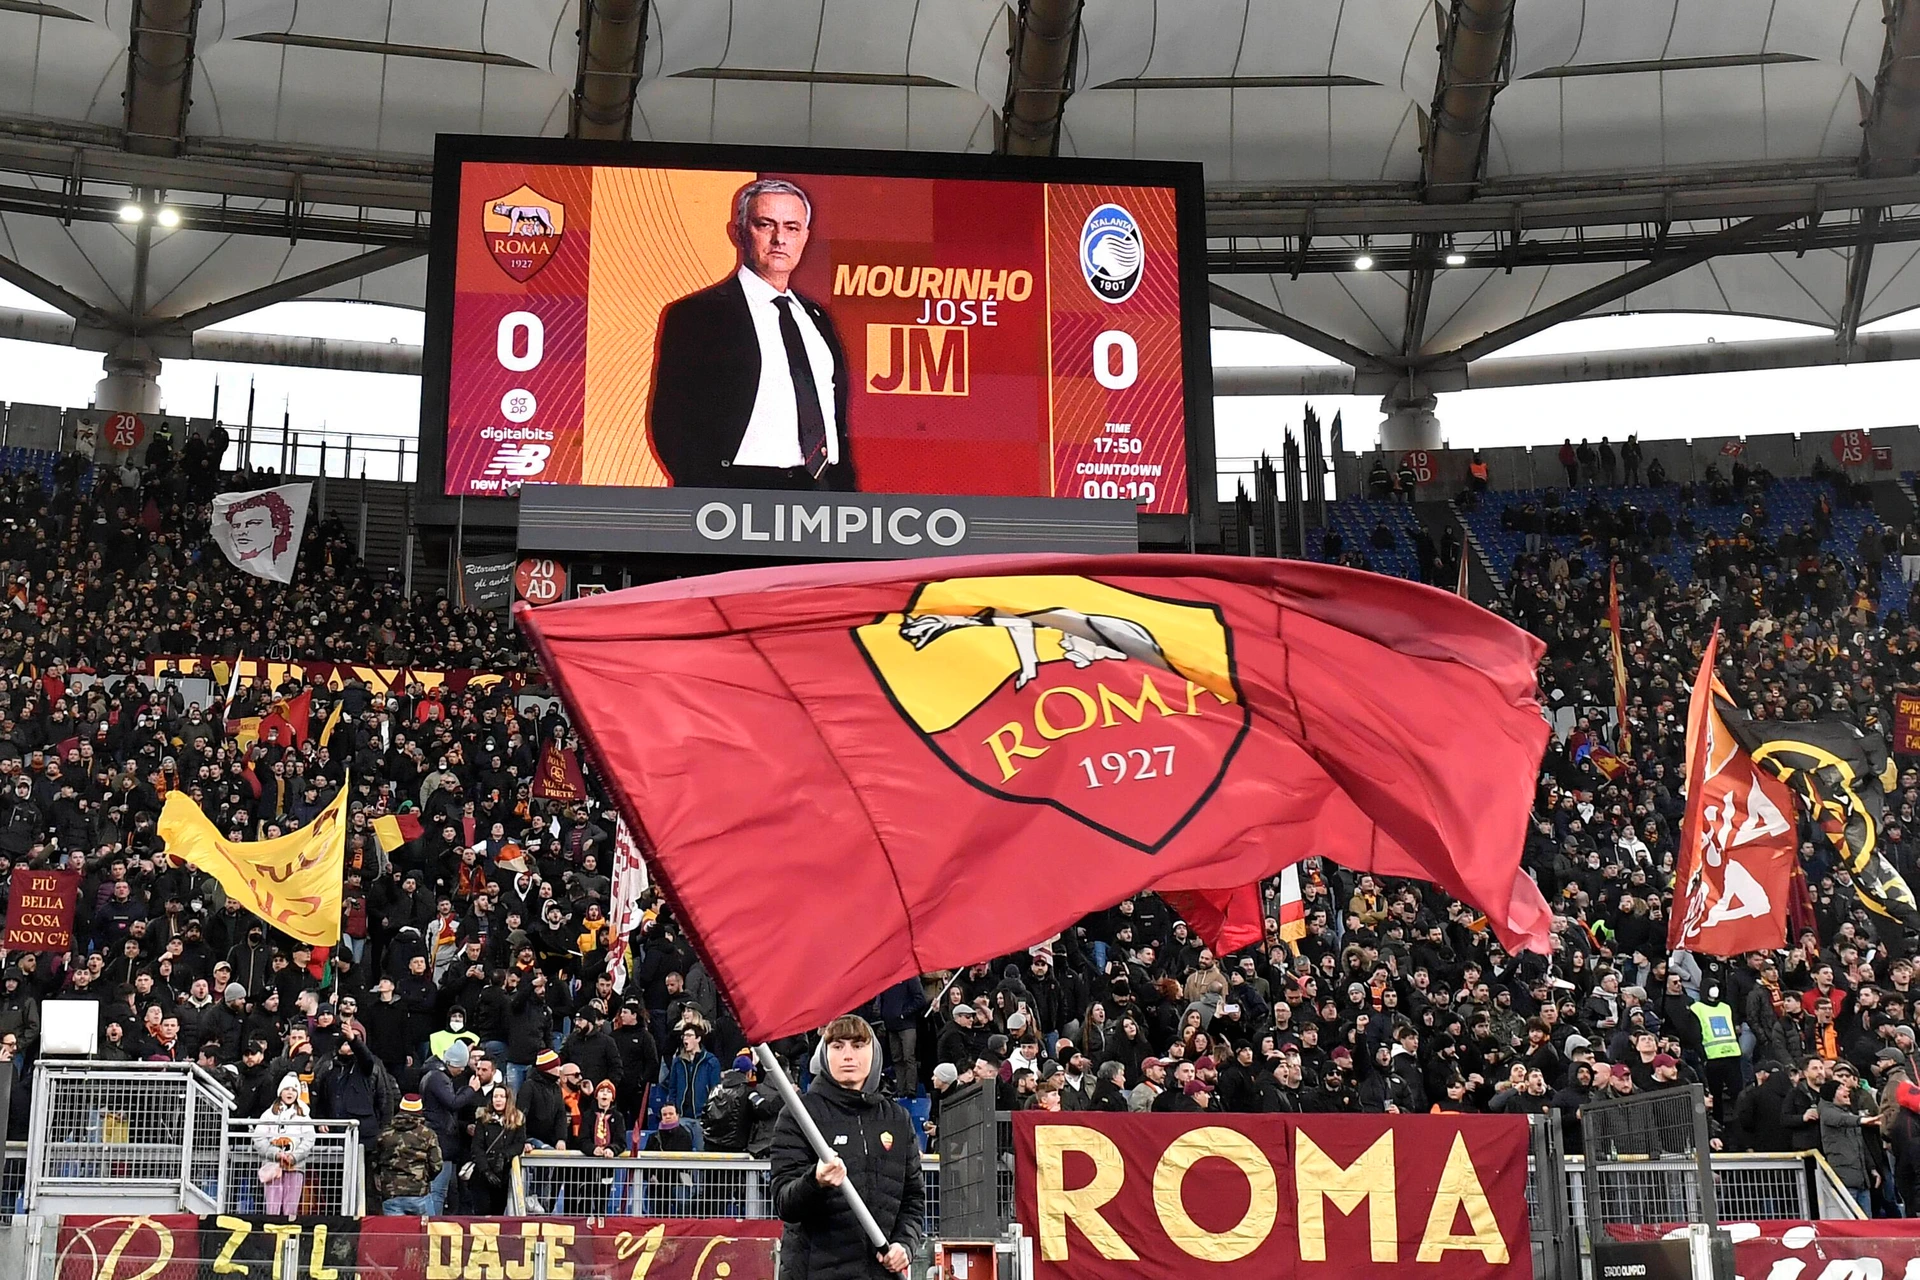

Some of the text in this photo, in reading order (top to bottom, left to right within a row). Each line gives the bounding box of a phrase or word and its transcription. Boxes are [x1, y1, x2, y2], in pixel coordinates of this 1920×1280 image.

[1090, 217, 1132, 232] ATALANTA
[494, 239, 551, 255] ROMA
[510, 259, 533, 269] 1927
[833, 264, 1034, 302] MOURINHO
[1099, 280, 1126, 291] 1907
[915, 294, 998, 326] JOSÉ
[496, 310, 545, 372] 0
[869, 327, 966, 393] JM
[1092, 329, 1139, 390] 0
[115, 414, 136, 430] 20
[1104, 422, 1131, 434] TIME
[112, 430, 135, 446] AS
[480, 426, 554, 442] digitalbits
[1840, 431, 1860, 447] 18
[1093, 437, 1143, 454] 17:50
[1409, 452, 1428, 467] 19
[1842, 447, 1863, 462] AS
[1076, 462, 1162, 477] COUNTDOWN
[470, 480, 500, 491] new
[1083, 480, 1156, 504] 00:10
[695, 501, 967, 547] OLIMPICO
[529, 558, 555, 578] 20
[525, 579, 557, 599] AD
[1078, 745, 1177, 789] 1927
[32, 876, 57, 891] PIÙ
[21, 895, 64, 910] BELLA
[21, 913, 60, 928] COSA
[8, 929, 45, 944] NON
[1034, 1124, 1510, 1263] ROMA
[212, 1215, 339, 1280] ZTL
[425, 1221, 576, 1280] DAJE
